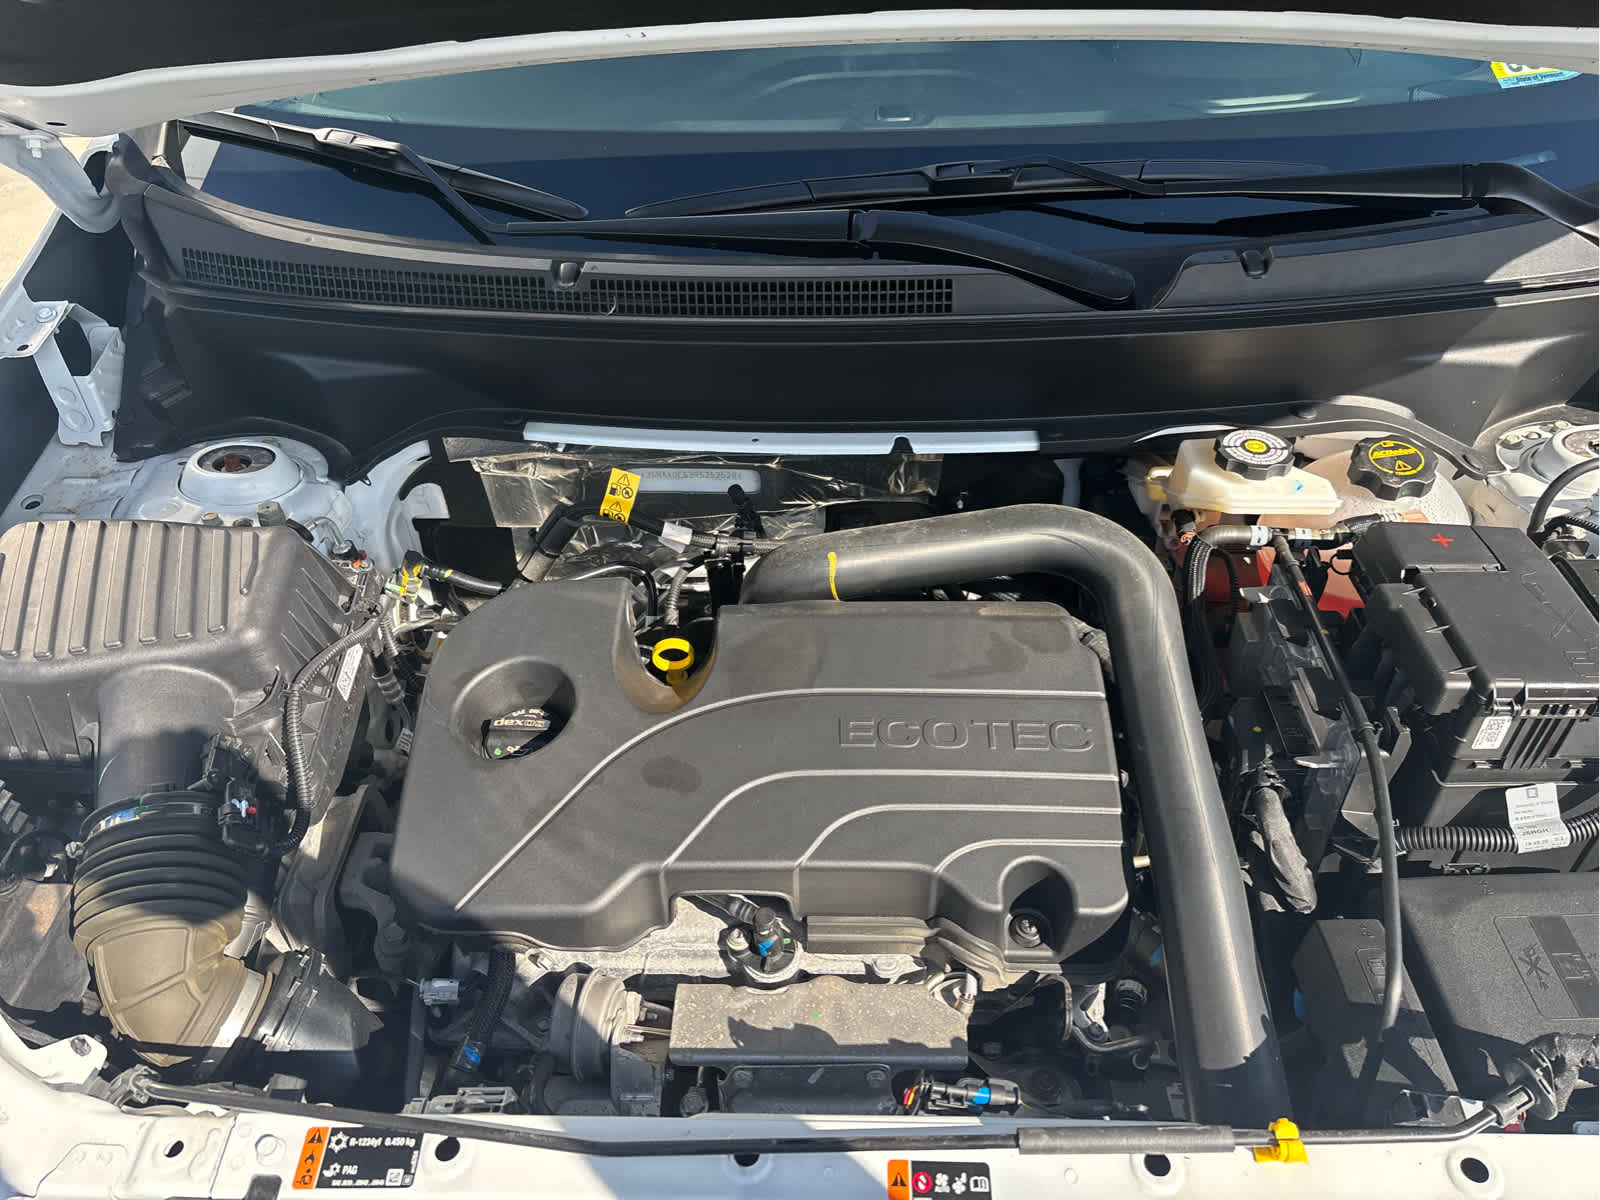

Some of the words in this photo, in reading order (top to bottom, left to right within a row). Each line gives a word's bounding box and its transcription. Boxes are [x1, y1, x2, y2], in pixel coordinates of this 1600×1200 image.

[838, 717, 1096, 752] ECOTEC
[405, 1137, 416, 1148] kg
[341, 1164, 359, 1176] PAG
